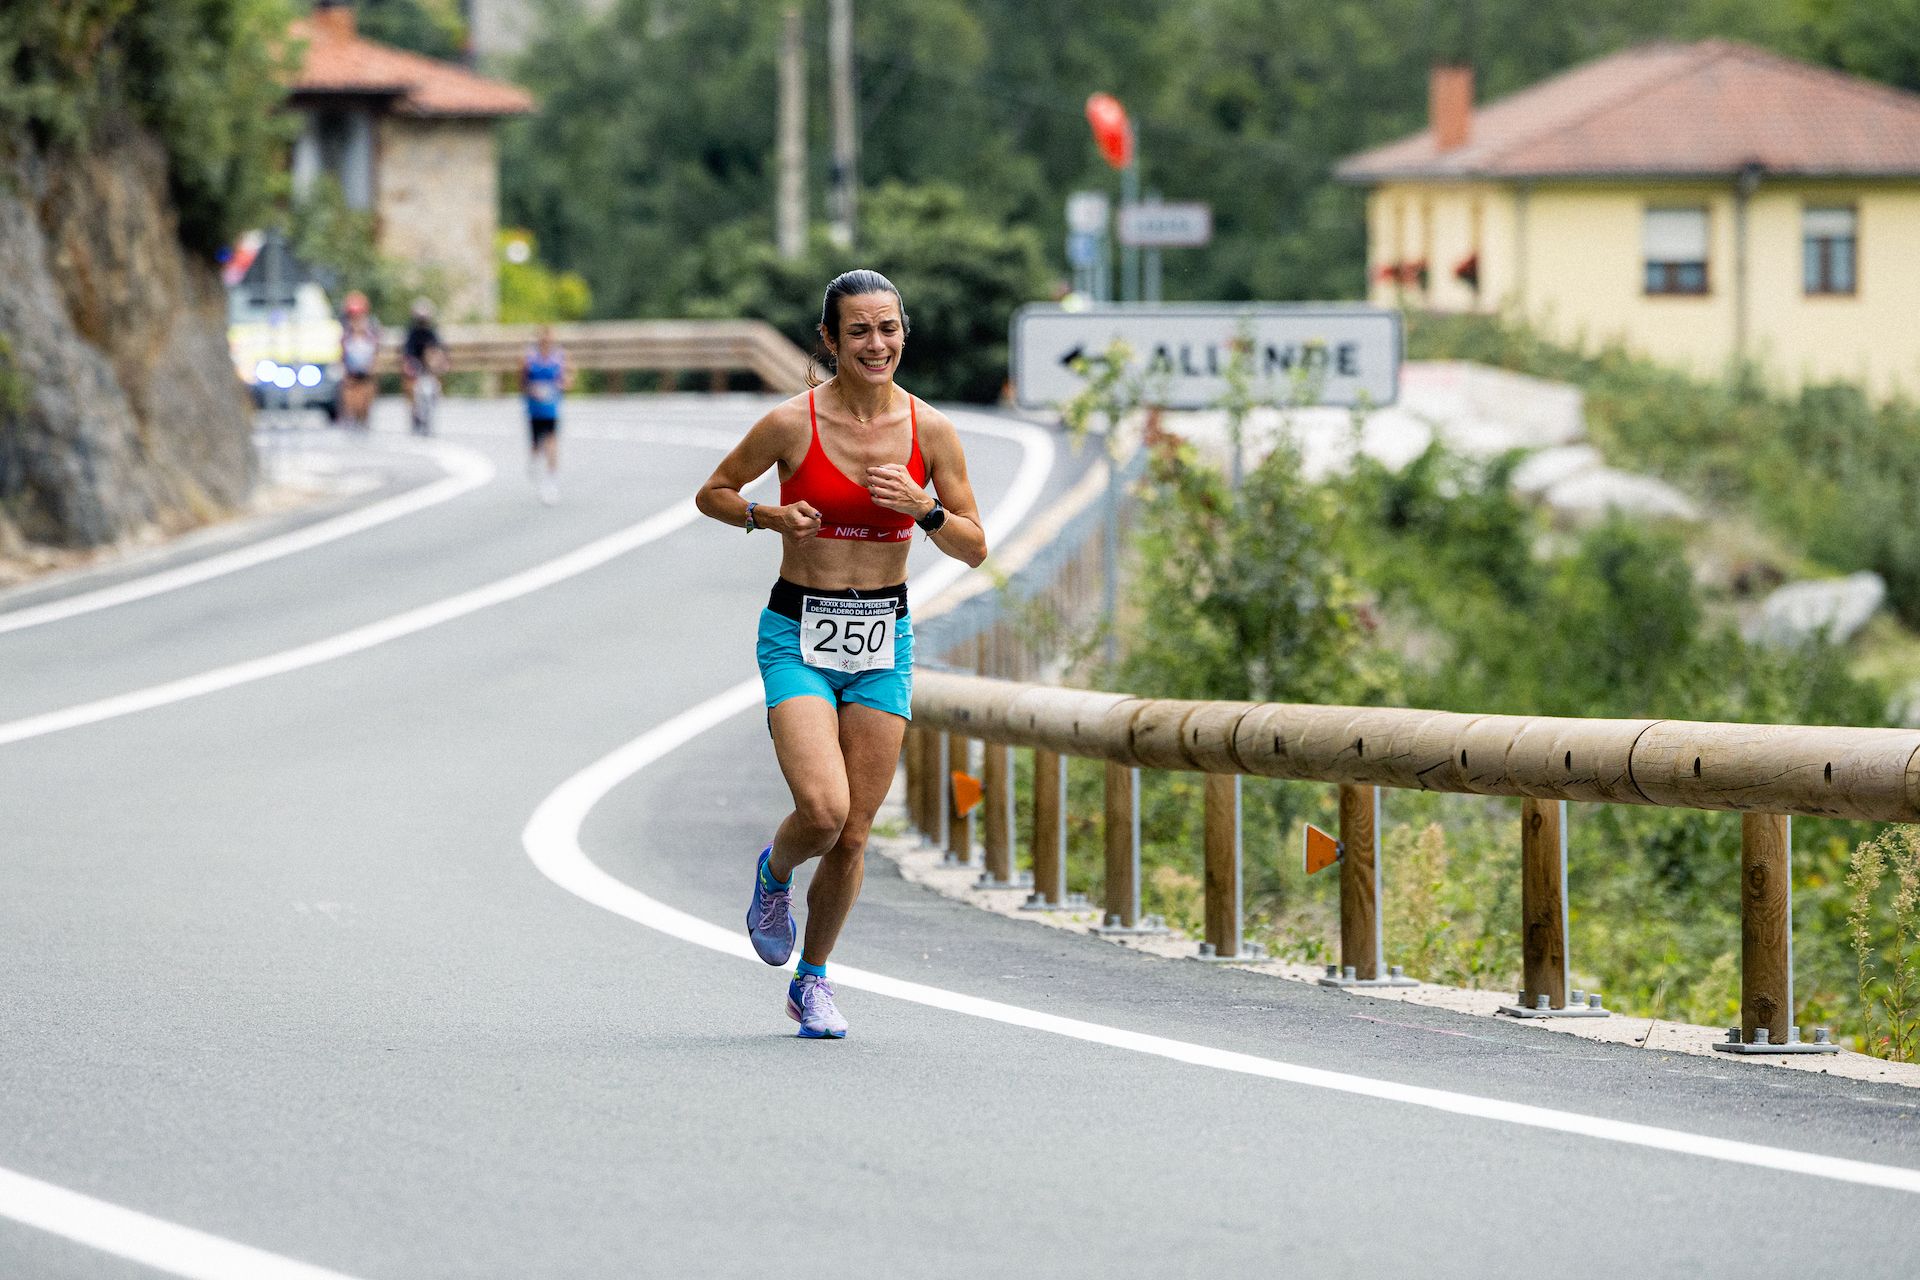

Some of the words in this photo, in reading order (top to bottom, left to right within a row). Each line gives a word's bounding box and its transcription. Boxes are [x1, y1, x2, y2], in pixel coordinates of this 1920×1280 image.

[1146, 343, 1359, 377] ALLNDE
[834, 527, 870, 538] NIKE
[819, 600, 839, 608] XXXIX
[839, 601, 863, 609] SUBIDA
[864, 601, 890, 609] PEDESTRE
[810, 606, 853, 615] DESFILADERO
[813, 619, 886, 656] 250
